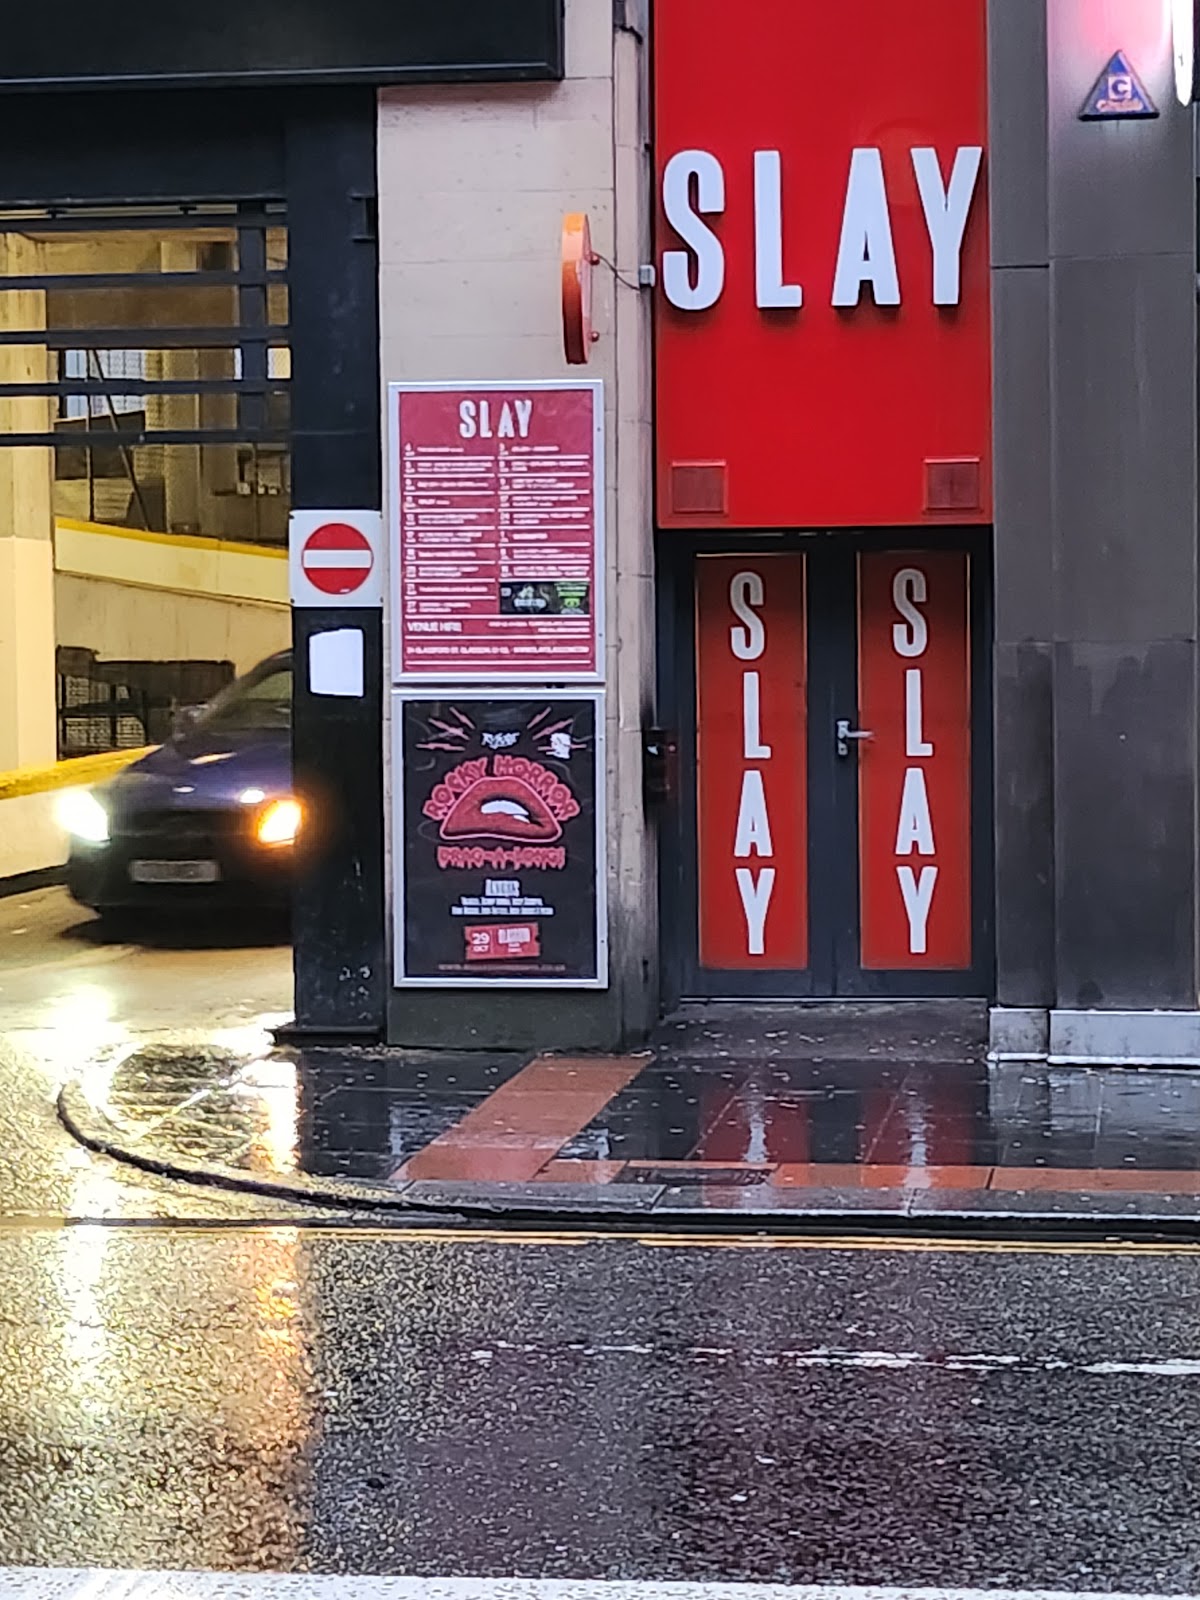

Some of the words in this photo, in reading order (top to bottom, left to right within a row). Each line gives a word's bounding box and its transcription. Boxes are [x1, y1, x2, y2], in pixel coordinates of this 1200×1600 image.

[663, 146, 982, 310] SLAY
[459, 399, 532, 438] SLAY
[422, 756, 488, 820] ROCKY
[494, 754, 581, 821] HORROR
[730, 571, 776, 954] SLAY
[893, 568, 938, 954] SLAY
[471, 932, 490, 945] 29
